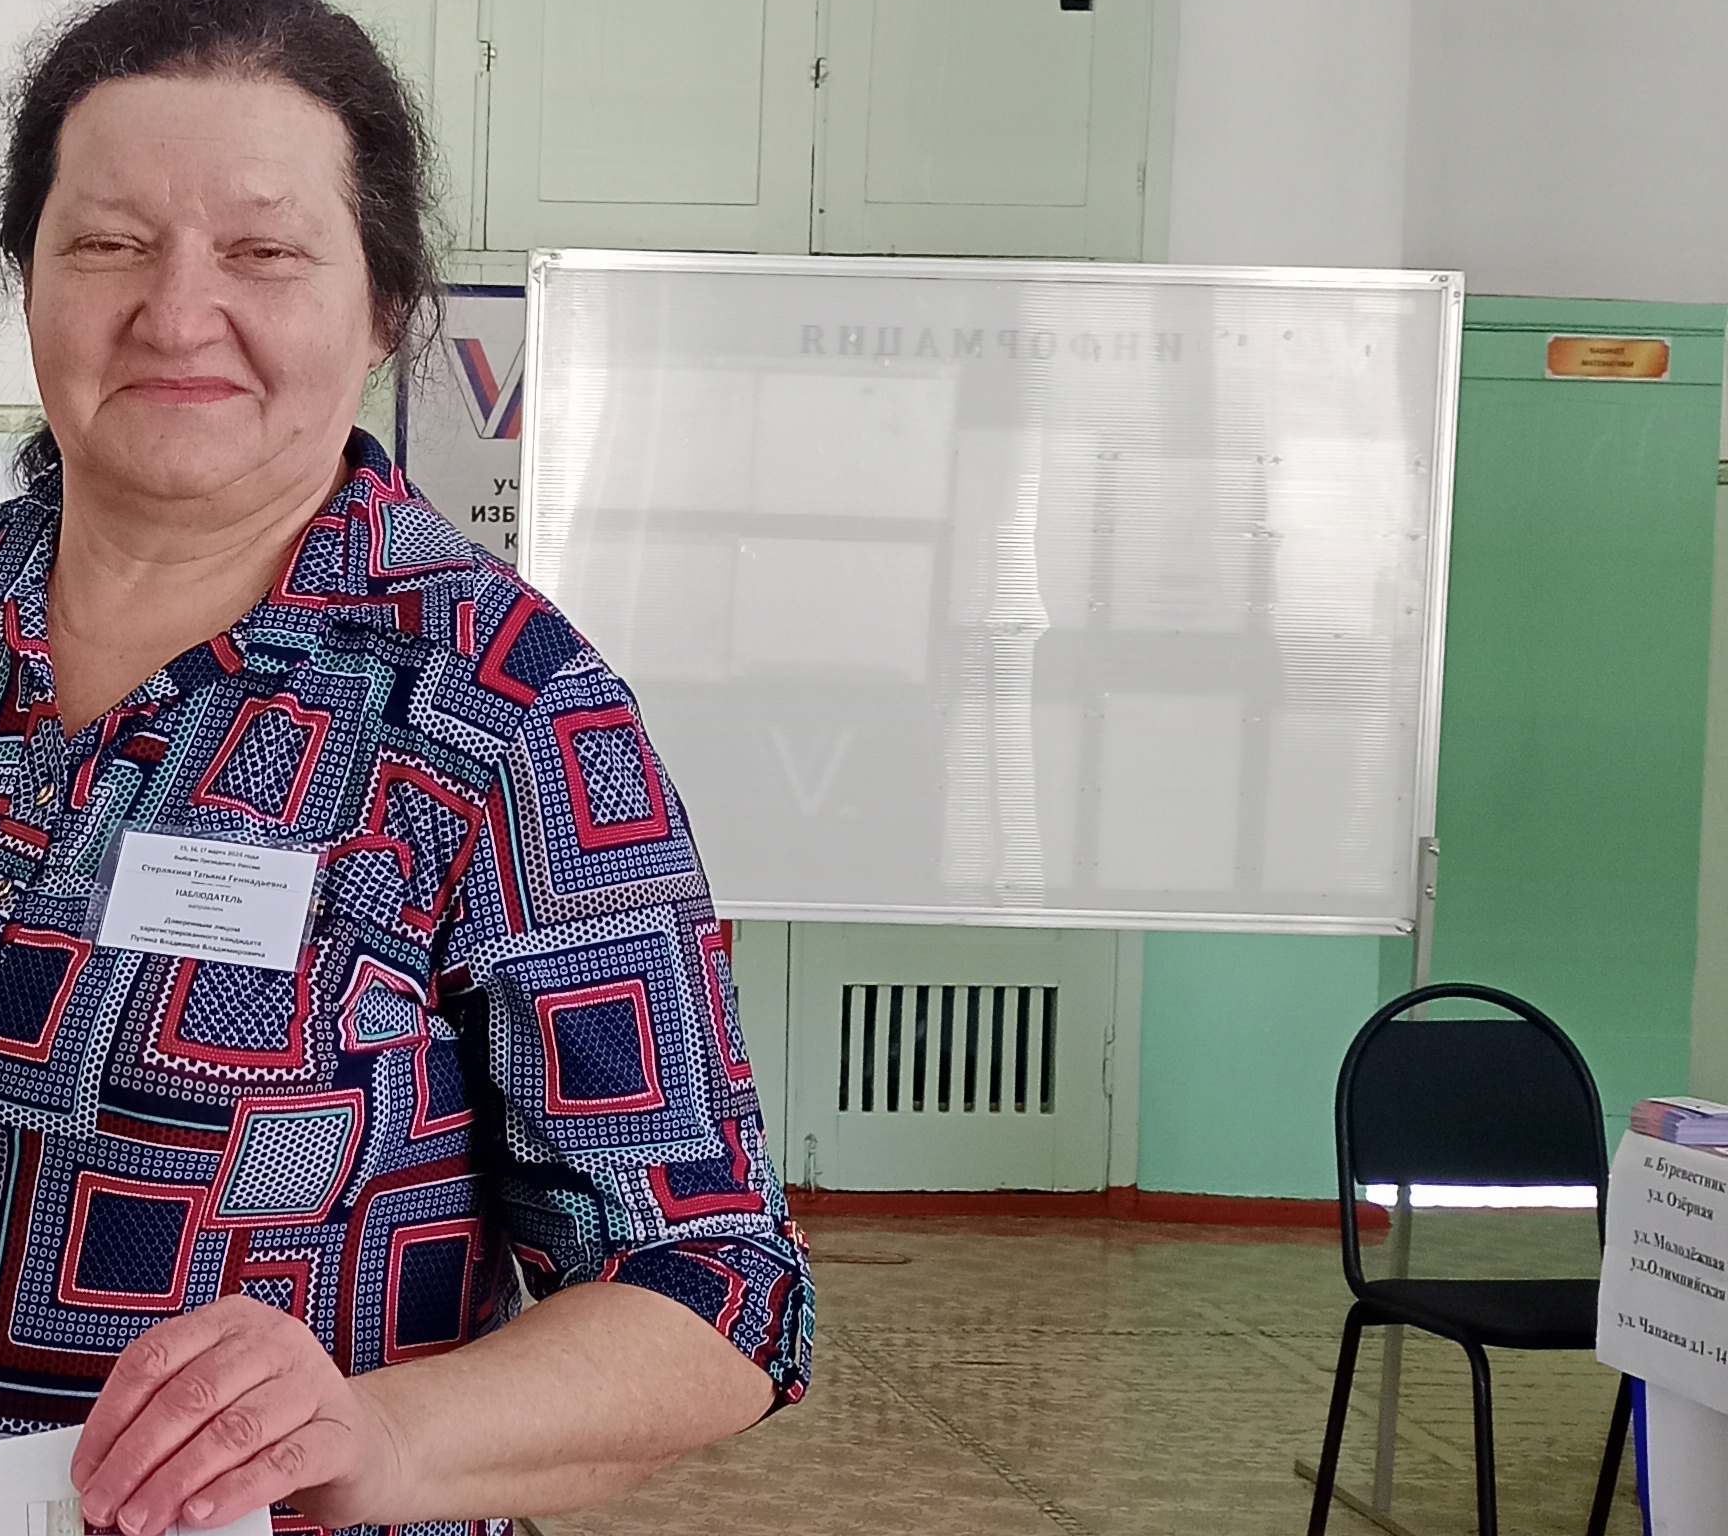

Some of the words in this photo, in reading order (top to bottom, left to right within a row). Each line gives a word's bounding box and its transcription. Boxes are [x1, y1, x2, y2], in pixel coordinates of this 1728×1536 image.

[471, 505, 515, 523] ИЗБ
[175, 889, 243, 904] НАБЛЮДАТЕЛЬ
[193, 870, 226, 882] Татьяна
[228, 874, 288, 890] Геннадьевна
[130, 934, 158, 945] Путина
[159, 938, 201, 950] Владимира
[201, 943, 266, 958] Владимировича
[1656, 1156, 1727, 1194] Буревестник
[1647, 1188, 1664, 1203] ул.
[1667, 1191, 1714, 1221] Озёрная
[1633, 1229, 1651, 1245] ул.
[1653, 1232, 1725, 1272] Молодёжная
[1629, 1256, 1726, 1301] ул.Олимпийская
[1617, 1312, 1636, 1328] ул.
[1639, 1316, 1687, 1348] Чапаева
